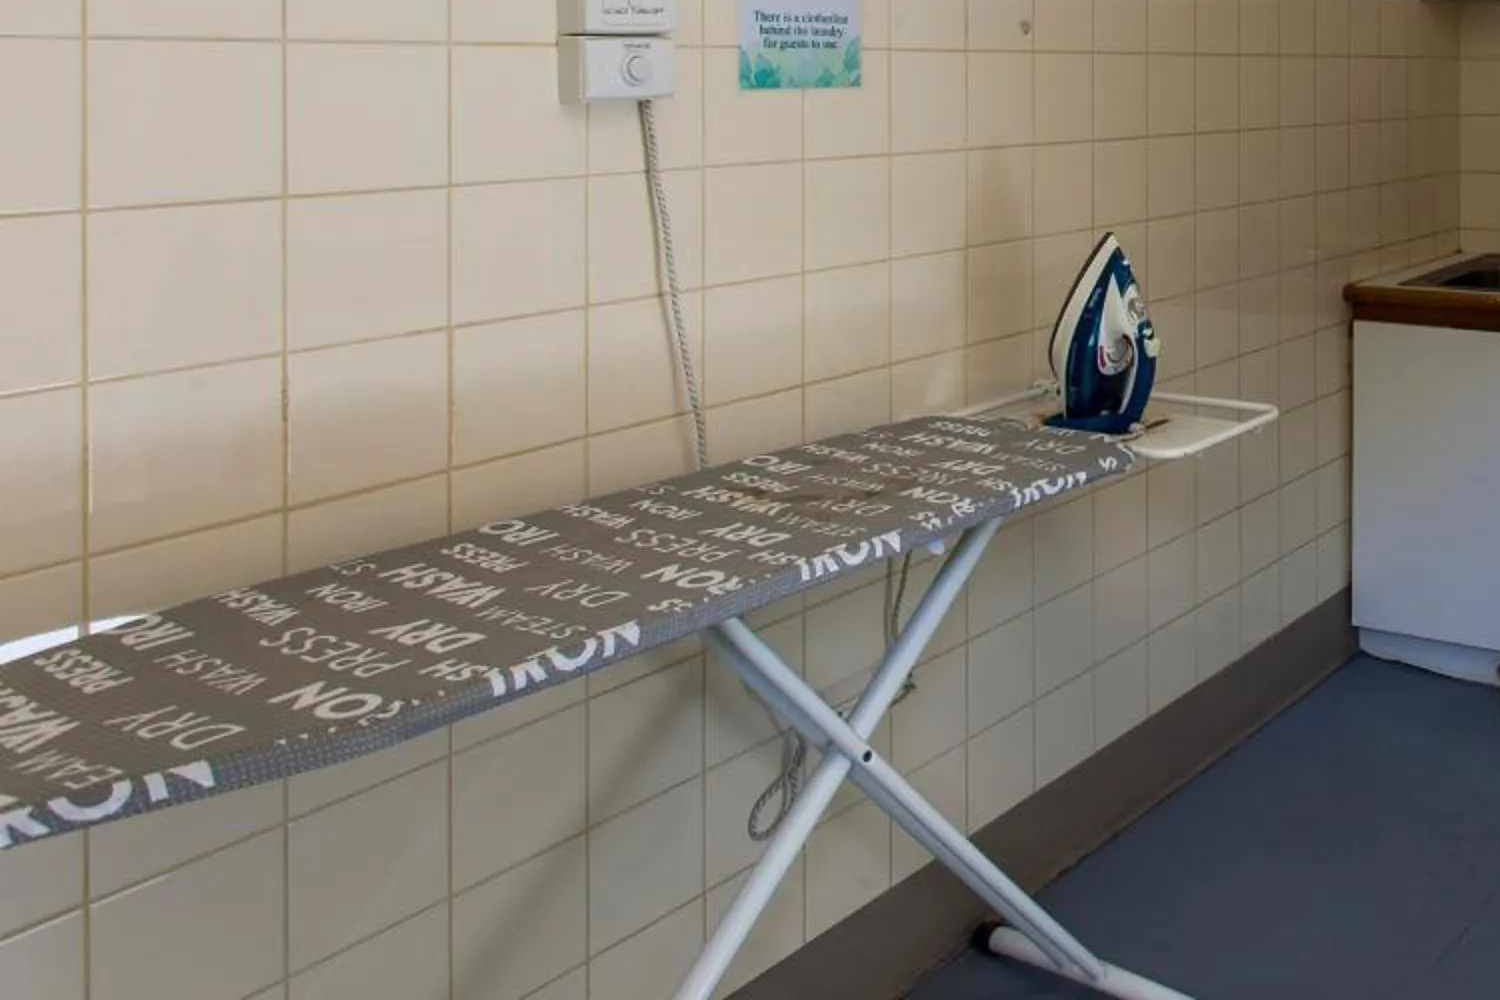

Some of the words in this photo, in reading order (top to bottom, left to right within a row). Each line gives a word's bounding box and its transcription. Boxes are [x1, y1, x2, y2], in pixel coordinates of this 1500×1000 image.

[754, 9, 781, 22] There
[699, 521, 793, 547] DRY
[304, 583, 390, 612] IRON
[375, 562, 506, 609] WASH
[524, 578, 633, 608] DRY
[211, 587, 301, 627] WASH
[258, 626, 413, 678] PRESS
[367, 618, 488, 654] DRY
[33, 649, 135, 694] PRESS
[153, 649, 268, 696] WASH
[103, 704, 247, 750] DRY
